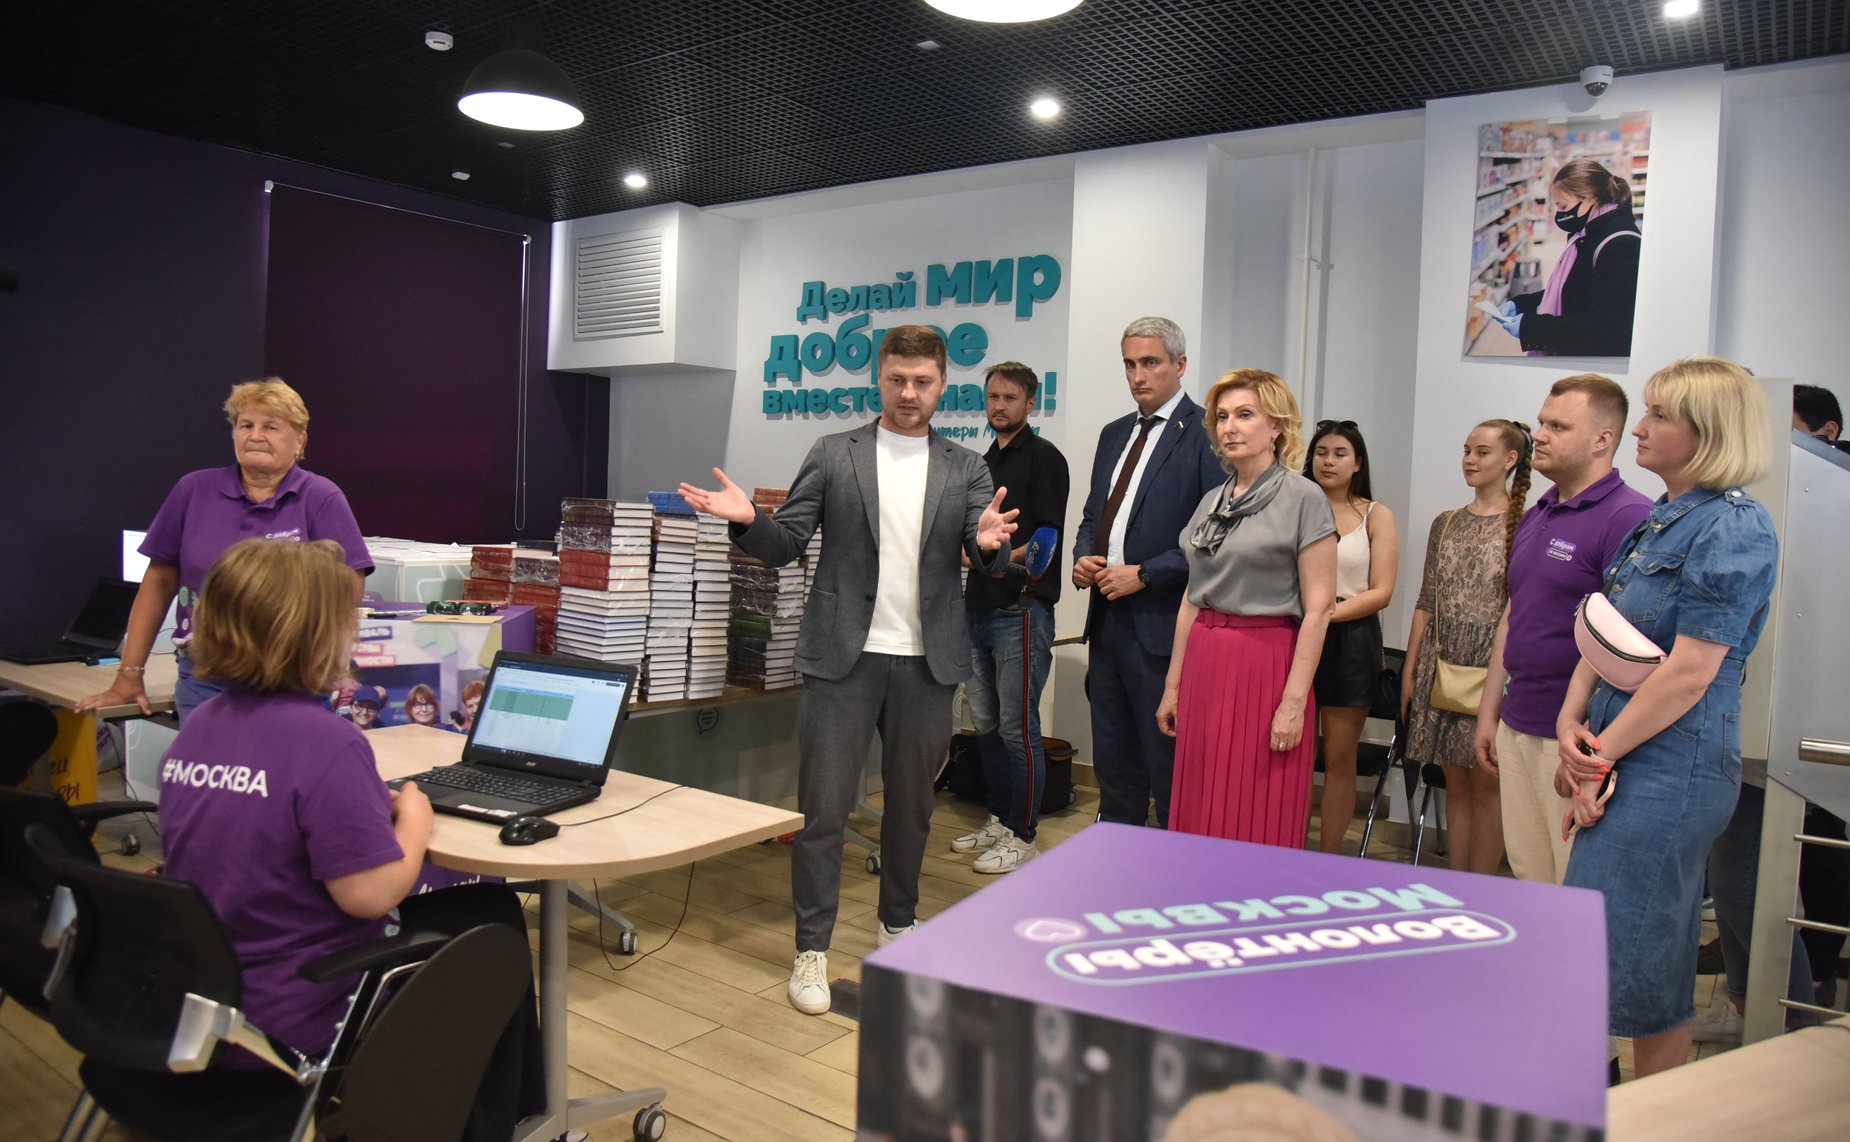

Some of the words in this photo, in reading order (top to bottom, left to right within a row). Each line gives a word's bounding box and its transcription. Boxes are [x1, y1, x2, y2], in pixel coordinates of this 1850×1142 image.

[797, 271, 917, 321] Делай
[926, 254, 1061, 317] мир
[764, 313, 988, 385] добе
[162, 759, 268, 798] #МОСКВА
[1084, 883, 1465, 934] Москвы
[1064, 915, 1502, 975] Волонтёры
